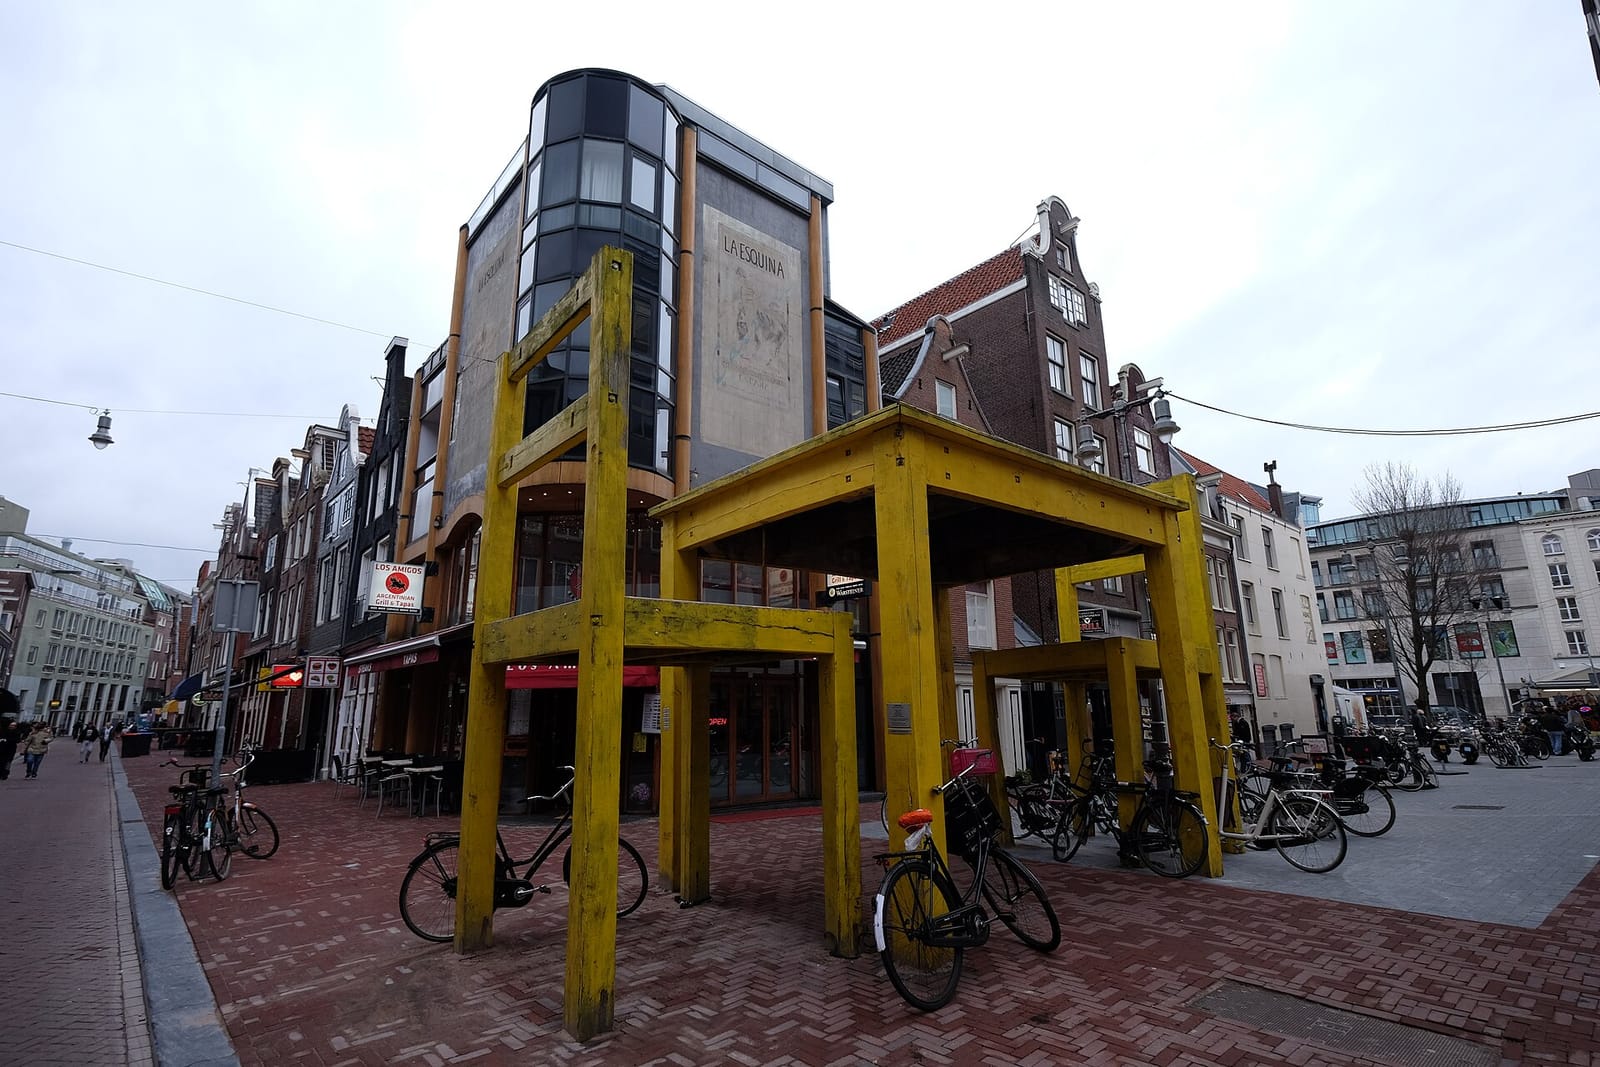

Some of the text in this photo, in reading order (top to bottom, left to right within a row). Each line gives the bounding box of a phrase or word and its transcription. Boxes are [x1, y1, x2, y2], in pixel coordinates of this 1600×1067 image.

[724, 235, 785, 279] LA ESQUINA
[375, 563, 423, 575] LOS AMIGOS
[375, 598, 390, 606] Grill
[376, 593, 416, 601] ARGENTINIAN
